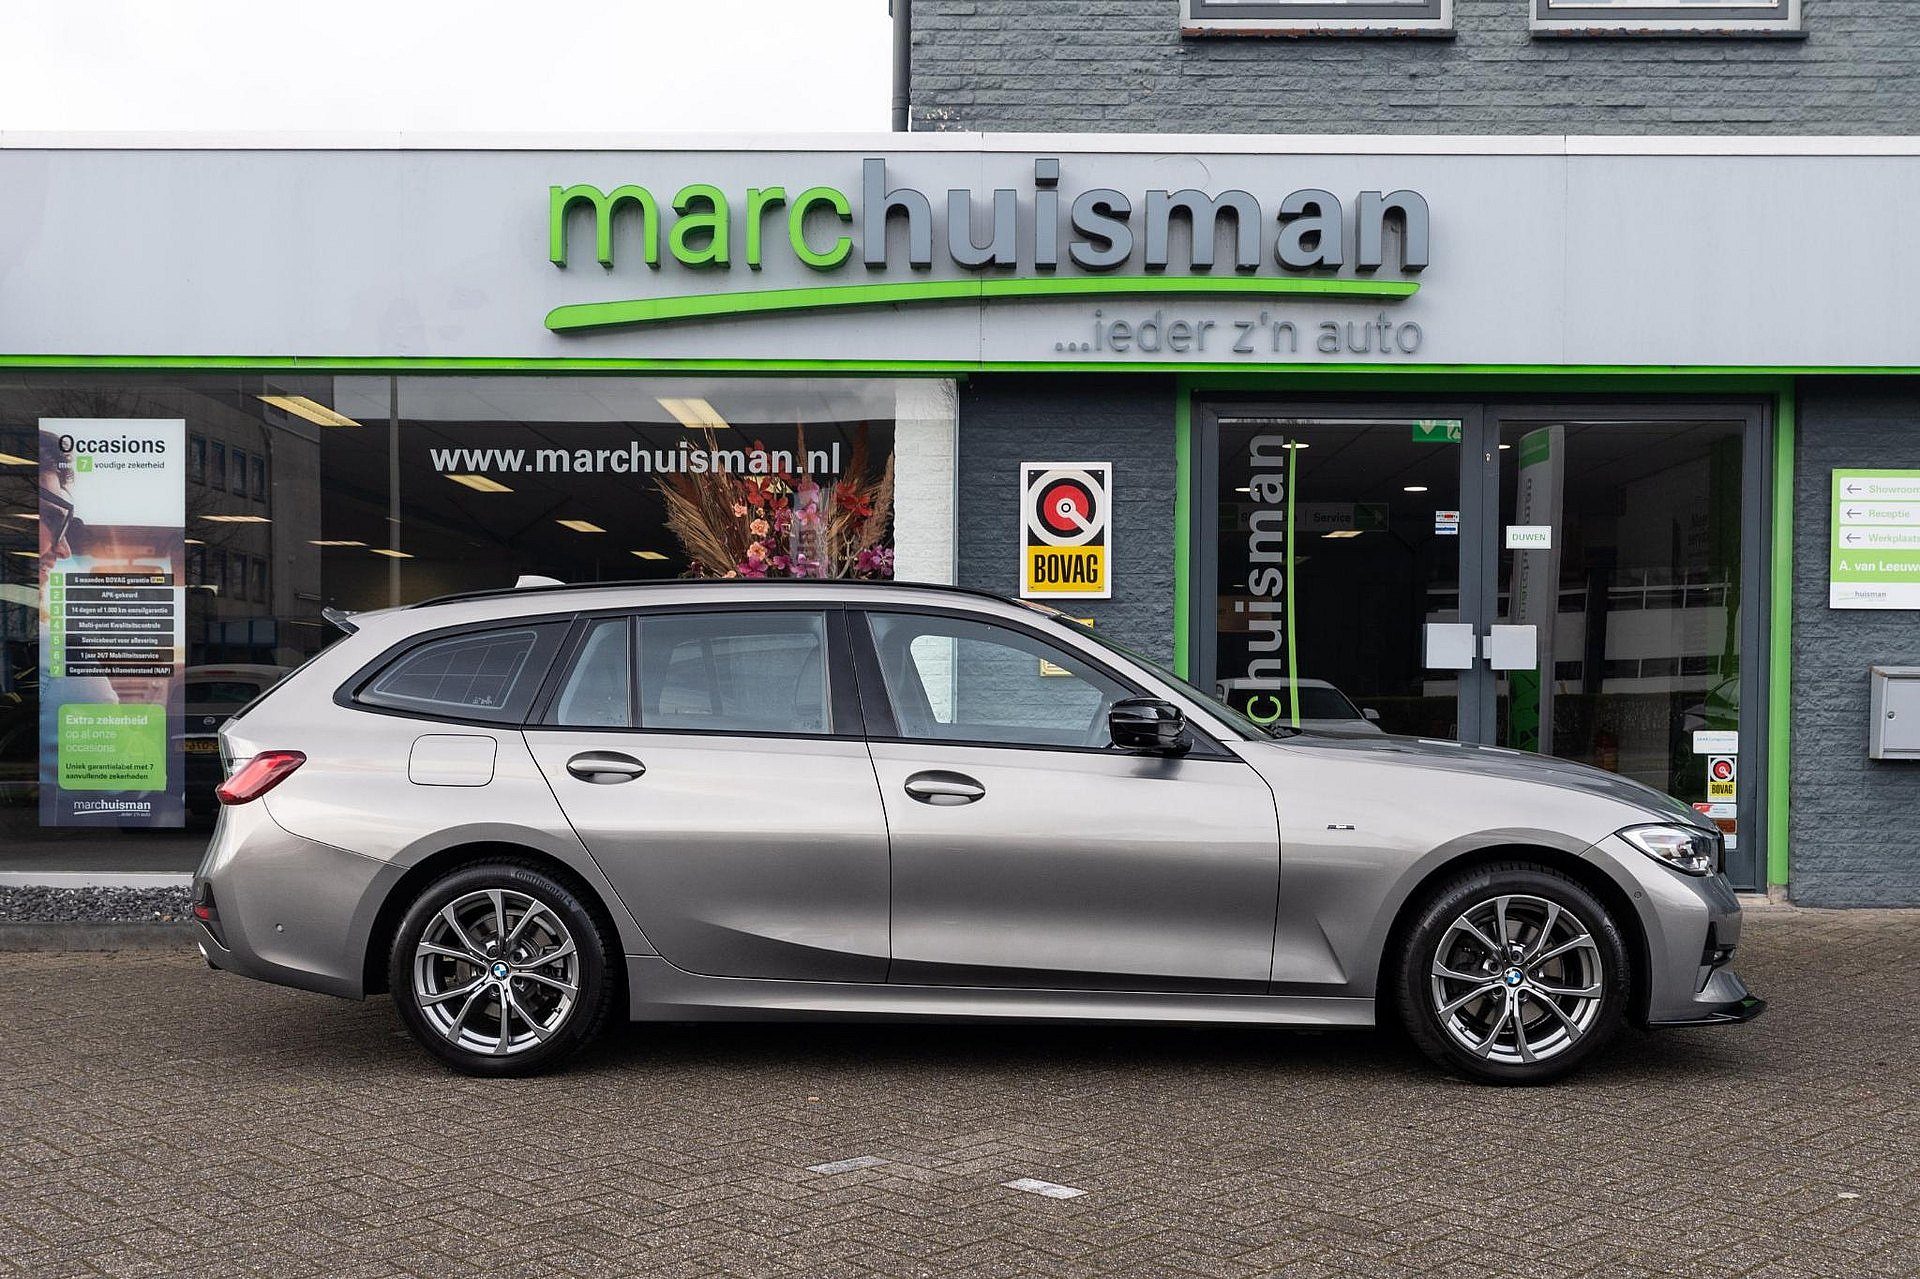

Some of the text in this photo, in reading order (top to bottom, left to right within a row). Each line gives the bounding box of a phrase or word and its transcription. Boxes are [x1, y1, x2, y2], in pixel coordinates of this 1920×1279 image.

[549, 158, 1430, 273] marchuisman
[1232, 311, 1297, 353] z'n
[1317, 311, 1423, 353] auto
[59, 434, 166, 453] Occasions
[430, 441, 840, 474] www.marchuisman.nl
[94, 461, 126, 471] voudige
[128, 461, 165, 469] zekerheid
[1313, 512, 1351, 523] Service
[1868, 509, 1910, 519] Receptie
[1512, 533, 1546, 541] DUWEN
[1034, 554, 1098, 584] BOVAG
[1839, 560, 1851, 571] A.
[1855, 563, 1875, 572] van
[65, 715, 148, 725] Extra zekerheid
[65, 731, 80, 740] op
[81, 729, 91, 738] al
[87, 763, 133, 771] garantielabel
[1711, 784, 1733, 794] BOVAG
[73, 799, 151, 810] marchuisman
